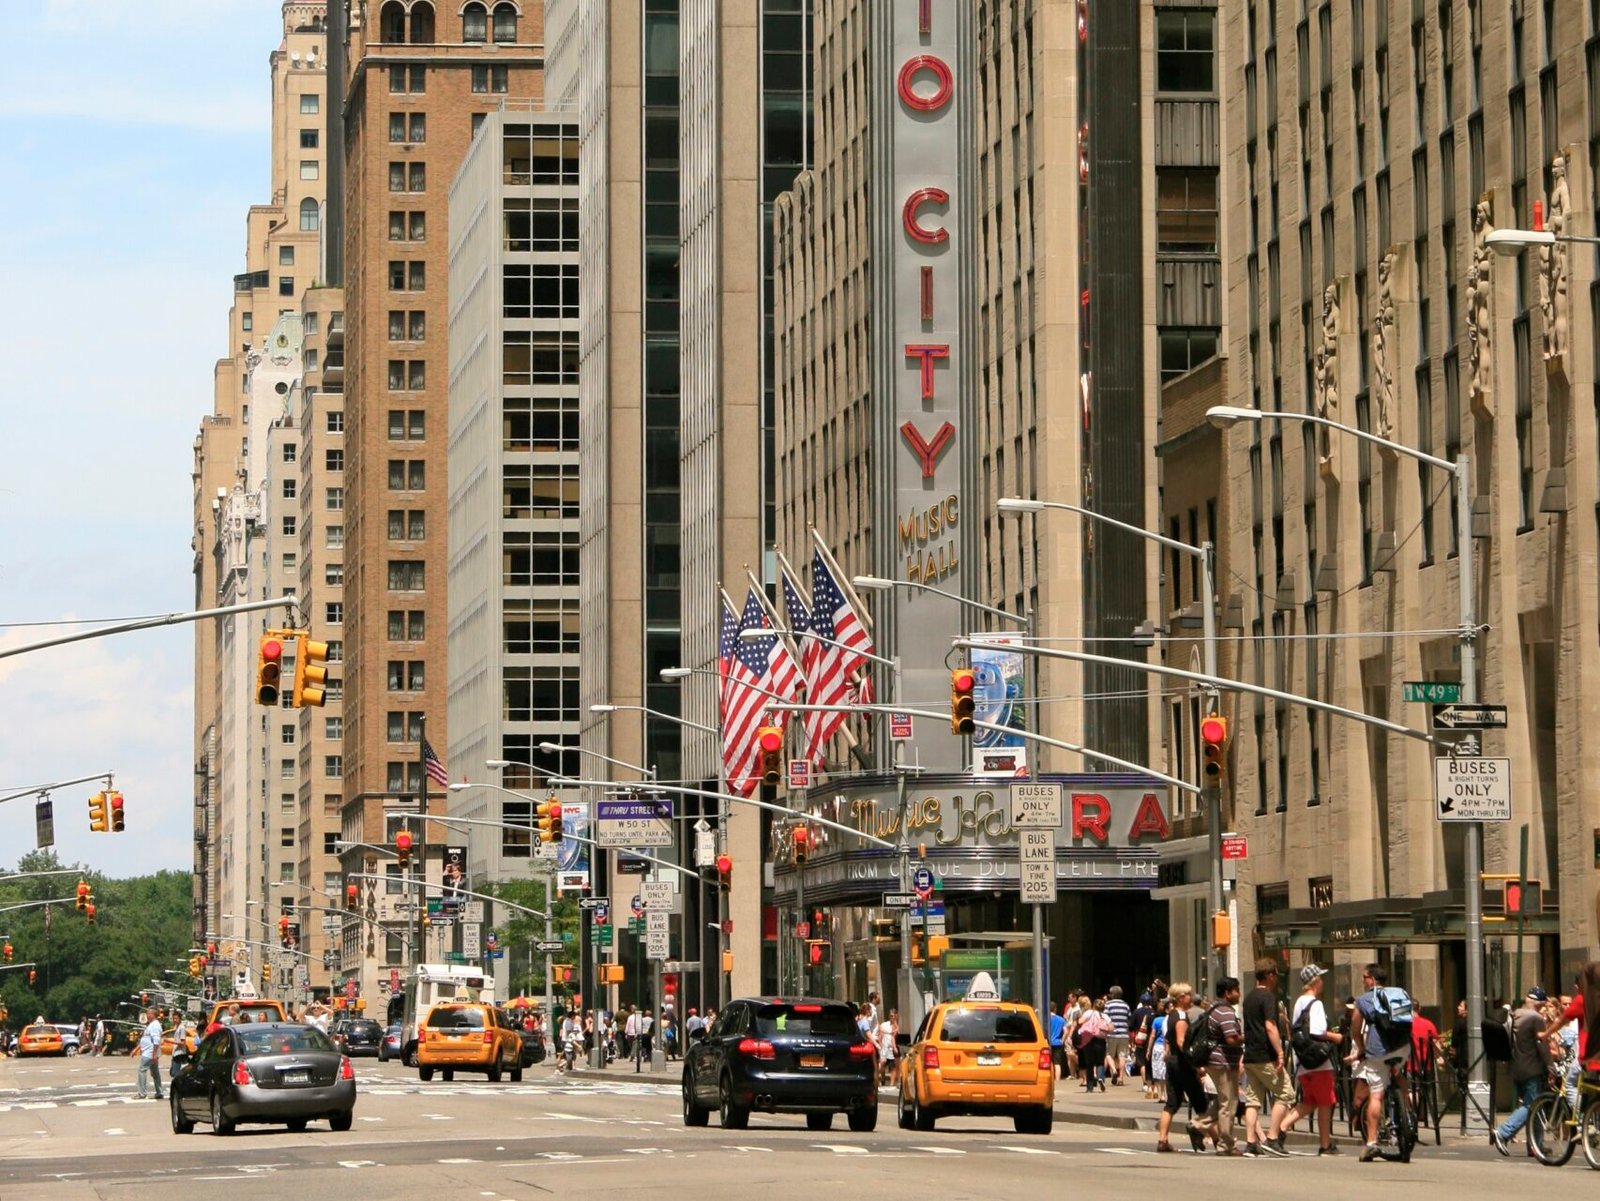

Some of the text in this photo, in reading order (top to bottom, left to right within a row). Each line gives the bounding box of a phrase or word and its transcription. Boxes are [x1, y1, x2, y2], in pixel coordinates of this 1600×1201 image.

[900, 186, 956, 478] CITY
[898, 495, 958, 552] MUSIC
[907, 540, 957, 596] HALL
[1415, 684, 1457, 700] W 49 ST
[1442, 711, 1497, 721] ONE WAY
[1449, 761, 1497, 774] BUSES
[1018, 787, 1054, 796] BUSES
[1454, 784, 1492, 796] ONLY
[609, 806, 655, 815] THRU STREET
[1022, 802, 1050, 811] ONLY
[935, 791, 1020, 845] Ha
[1457, 809, 1508, 817] MON THRU FRI
[626, 820, 638, 828] 50
[641, 820, 651, 828] ST
[1027, 834, 1047, 845] BUS
[1025, 848, 1050, 858] LANE
[847, 863, 879, 880] FROM
[890, 861, 962, 877] CRUE
[979, 861, 1007, 876] DU
[1026, 863, 1041, 871] TOW
[647, 891, 666, 899] ONLY
[649, 923, 666, 931] LANE
